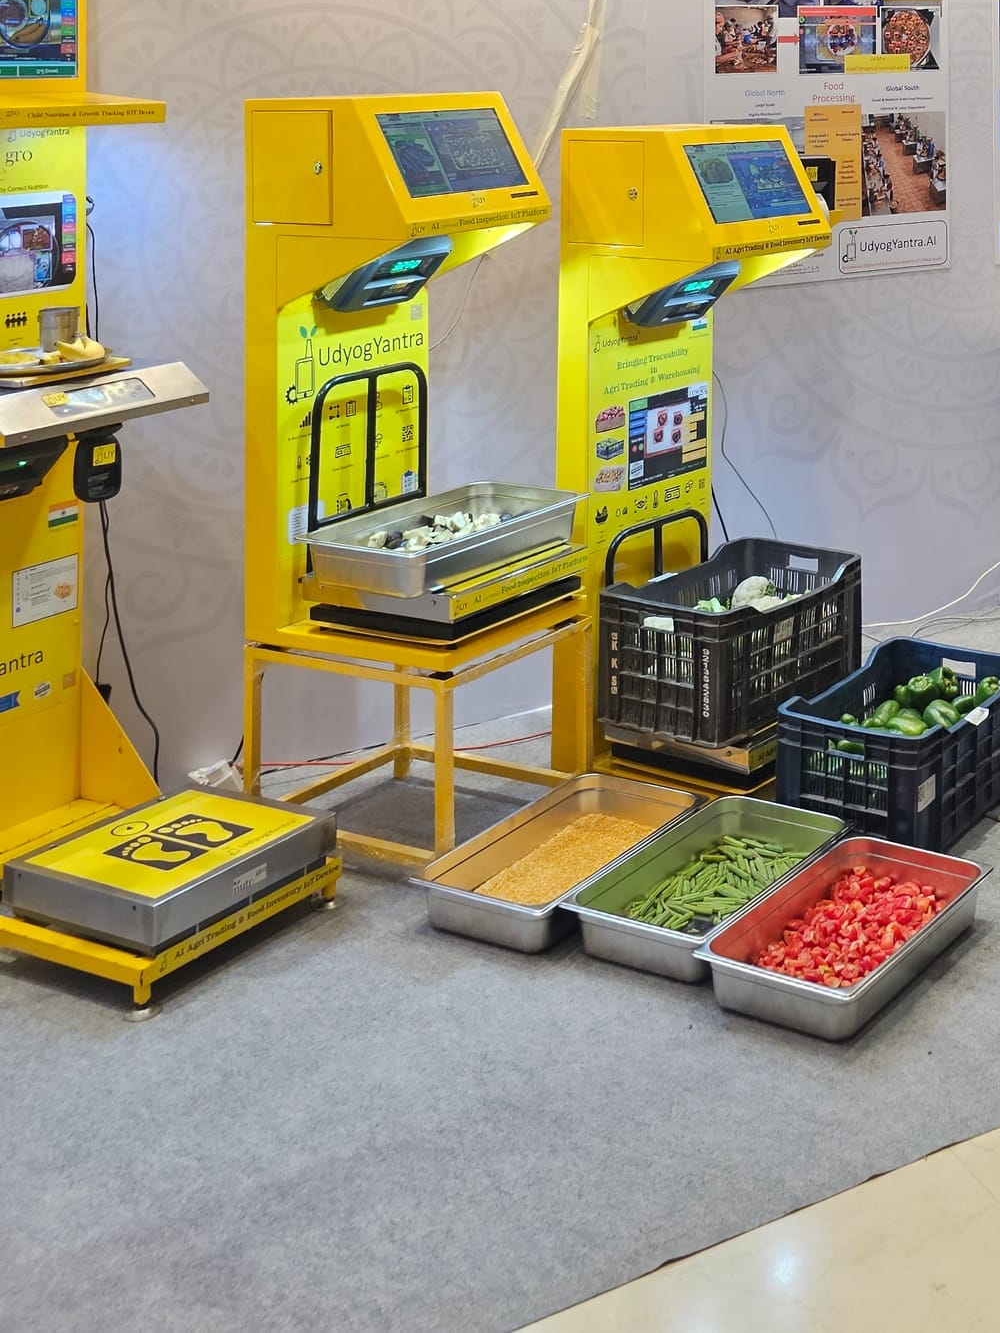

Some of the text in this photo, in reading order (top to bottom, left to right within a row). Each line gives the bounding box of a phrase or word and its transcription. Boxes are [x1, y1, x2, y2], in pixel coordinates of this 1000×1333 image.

[745, 89, 766, 97] Global
[824, 82, 844, 90] Food
[812, 94, 855, 104] Processing
[20, 128, 70, 139] UdyogYantra
[5, 150, 33, 167] gro
[459, 217, 475, 226] Food
[476, 213, 509, 225] Inspection
[522, 208, 548, 218] Platform
[733, 247, 744, 255] Agri
[745, 244, 764, 252] Trading
[782, 237, 805, 246] Inventory
[814, 234, 830, 242] Device
[859, 235, 936, 253] UdyogYantra.AI
[318, 330, 424, 367] UdyogYantra
[617, 347, 688, 370] Bringing Traceability
[650, 366, 658, 374] in
[603, 383, 620, 395] Agri
[621, 377, 649, 391] Trading
[658, 365, 701, 382] Warehousing
[103, 450, 115, 462] UY
[501, 582, 516, 594] Food
[517, 571, 550, 590] Inspection
[562, 554, 588, 570] Platform
[174, 948, 185, 960] AI
[187, 938, 204, 954] Agri
[206, 921, 237, 943] Trading
[247, 905, 265, 920] Food
[265, 884, 303, 912] Inventory
[315, 864, 340, 883] Device
